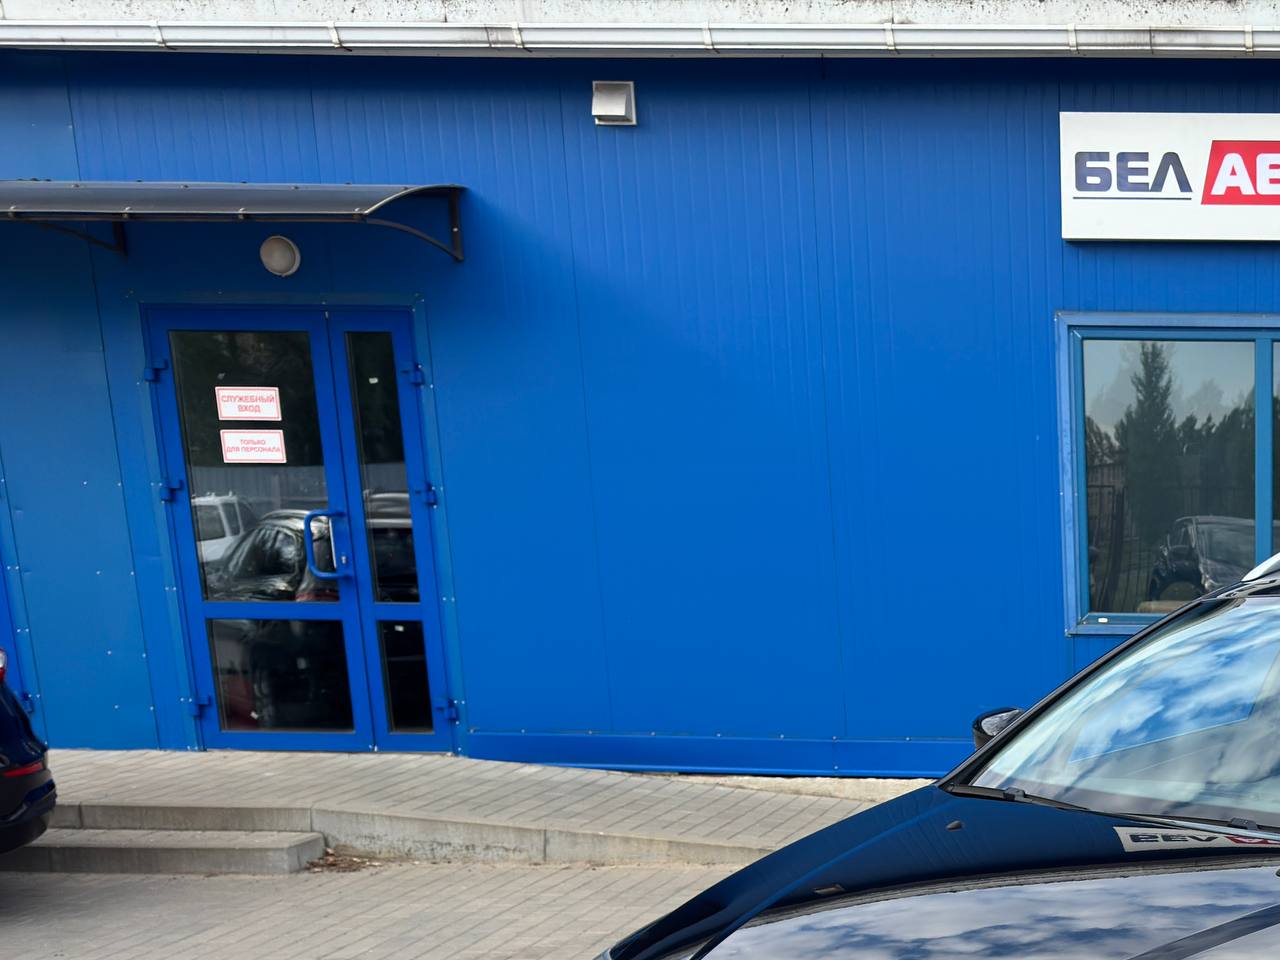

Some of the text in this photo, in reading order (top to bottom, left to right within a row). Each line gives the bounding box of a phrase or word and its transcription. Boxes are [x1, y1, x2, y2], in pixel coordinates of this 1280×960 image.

[1073, 151, 1193, 193] БЕЛ
[221, 395, 275, 403] СЛУЖЕБНЫЙ
[238, 405, 261, 413] ВХОД
